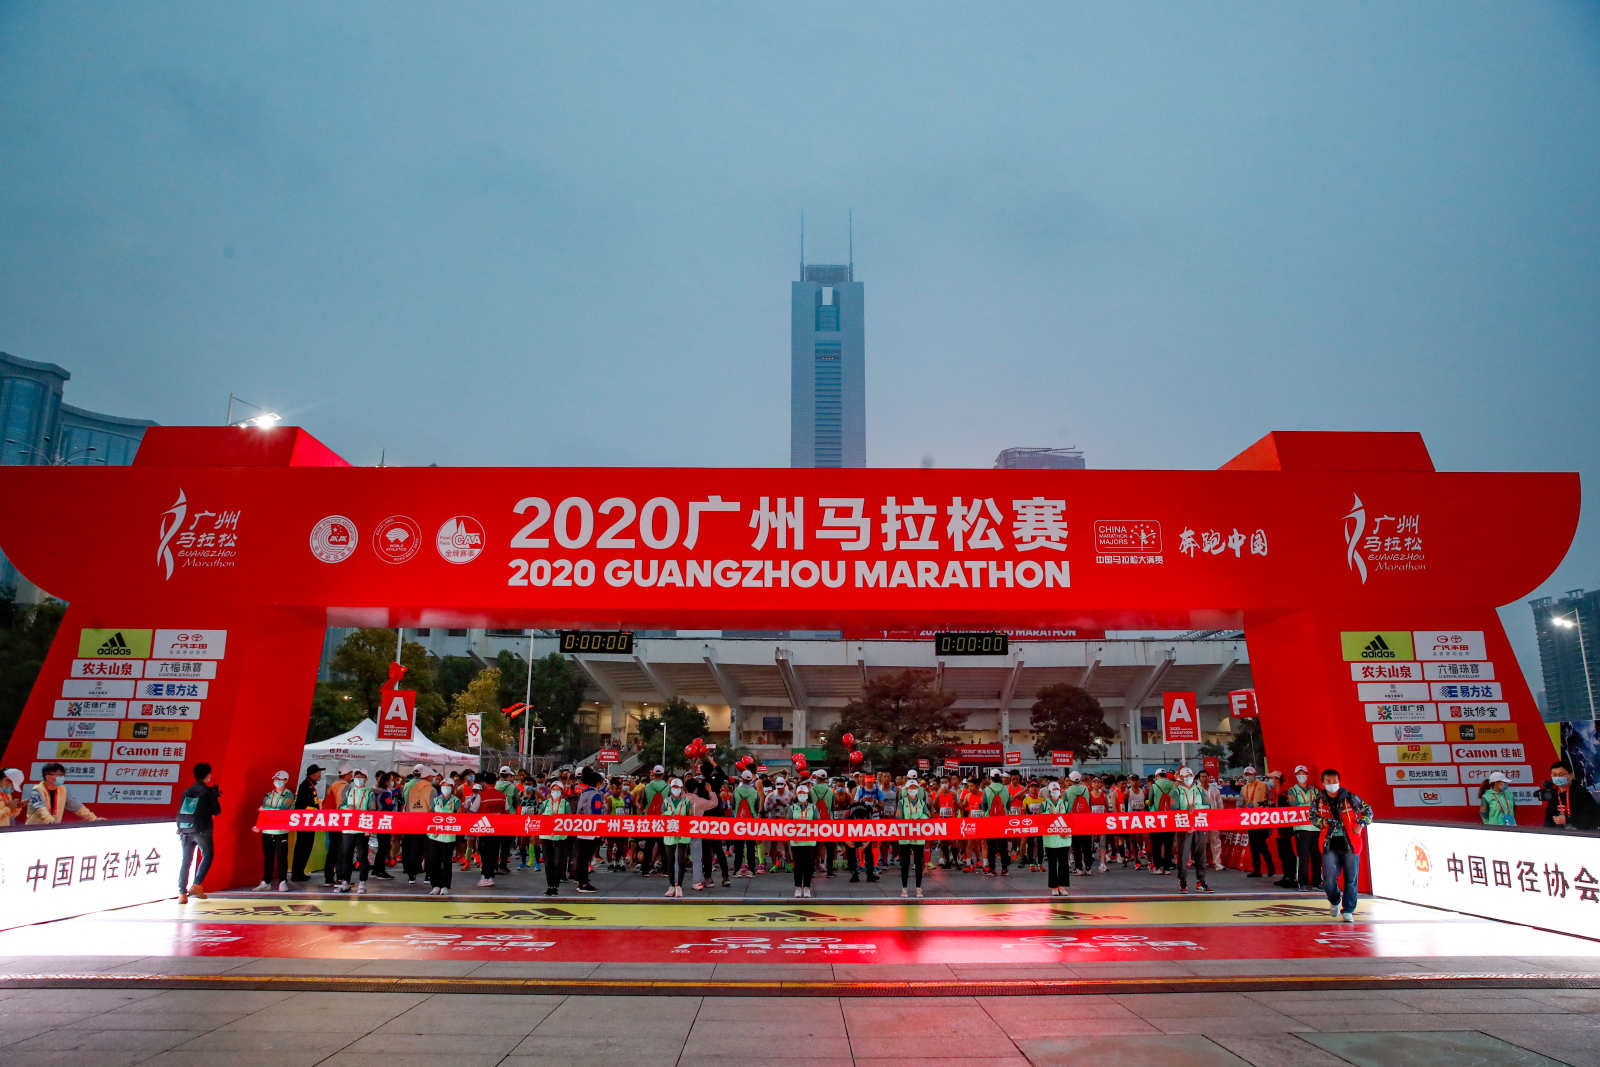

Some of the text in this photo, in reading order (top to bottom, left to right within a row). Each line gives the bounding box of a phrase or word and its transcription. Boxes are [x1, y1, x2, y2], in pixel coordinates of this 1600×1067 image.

[189, 510, 241, 530] 广州
[510, 495, 1069, 552] 2020广州马拉松赛
[1373, 514, 1420, 534] 广州
[1099, 525, 1127, 533] CHINA
[176, 532, 238, 548] 马拉松
[1179, 526, 1268, 558] 奔跑中国
[1363, 536, 1423, 551] 马拉松
[508, 558, 1071, 588] 2020 GUANGZHOU MARATHON
[565, 634, 628, 650] 0:00:00
[942, 637, 1002, 651] 0:00:00
[97, 646, 131, 656] adidas
[1361, 649, 1396, 658] adidas
[82, 662, 133, 675] 农夫山泉
[1362, 665, 1412, 679] 农夫山泉
[165, 684, 198, 696] 易方达
[1460, 685, 1493, 698] 易方达
[154, 704, 190, 716] 敬修堂
[385, 697, 408, 720] A
[1169, 698, 1193, 722] A
[1231, 694, 1247, 715] F
[1463, 705, 1498, 718] 敬修堂
[117, 745, 184, 757] Canon 佳能
[1455, 748, 1523, 758] Canon 佳能
[66, 766, 95, 774] 保险集团
[289, 813, 394, 830] START 起点
[553, 818, 680, 833] 2020广州马拉松赛
[689, 820, 730, 835] 2020
[733, 821, 844, 838] GUANGZHOU
[848, 822, 948, 838] MARATHON
[1105, 812, 1209, 830] START 起点
[27, 848, 161, 892] 中国田径协会
[1447, 852, 1600, 903] 中国田径协会
